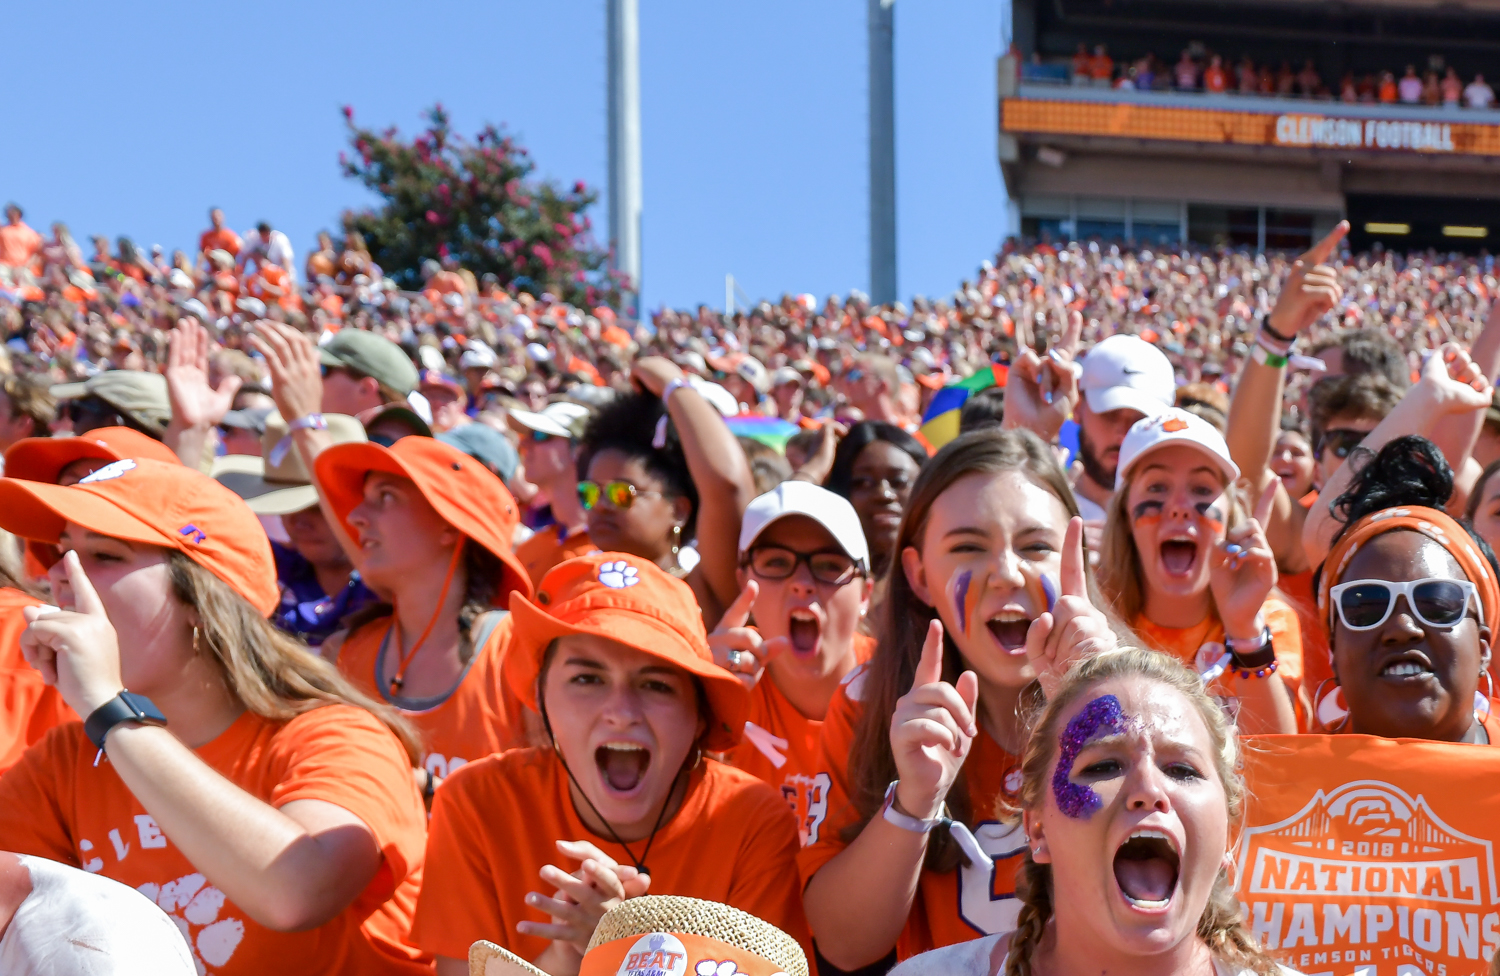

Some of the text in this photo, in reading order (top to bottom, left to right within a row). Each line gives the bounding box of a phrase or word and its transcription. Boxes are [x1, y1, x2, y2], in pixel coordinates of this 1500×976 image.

[1276, 115, 1454, 151] CLEMSON FOOTBALL
[1341, 840, 1394, 857] 2018
[1260, 854, 1475, 901] NATIONAL
[625, 950, 684, 972] BEAT
[1277, 944, 1447, 976] LEMSON TIGERS
